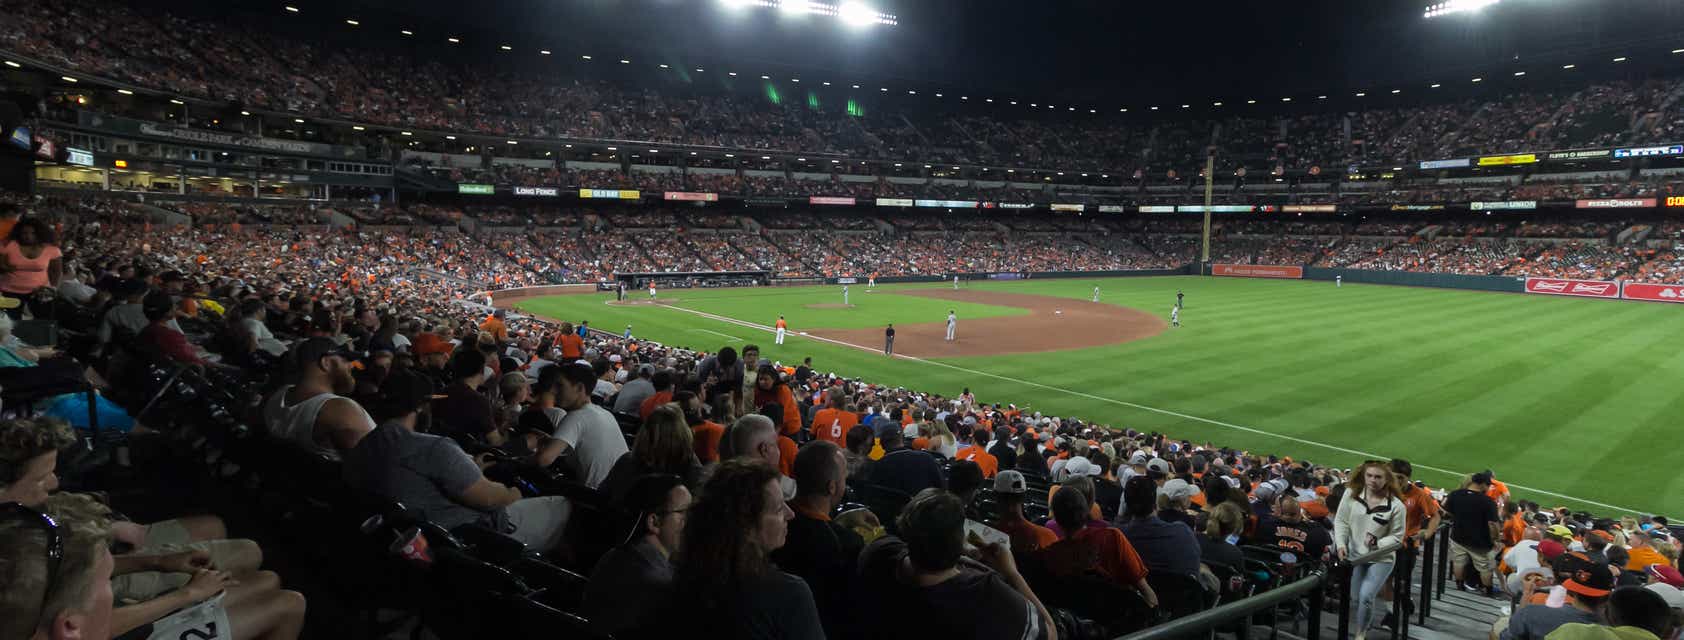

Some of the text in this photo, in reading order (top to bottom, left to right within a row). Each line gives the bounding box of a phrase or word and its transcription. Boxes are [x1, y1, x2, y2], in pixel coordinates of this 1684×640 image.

[516, 187, 535, 195] LONG
[830, 418, 842, 438] 6
[1275, 526, 1308, 542] JONES
